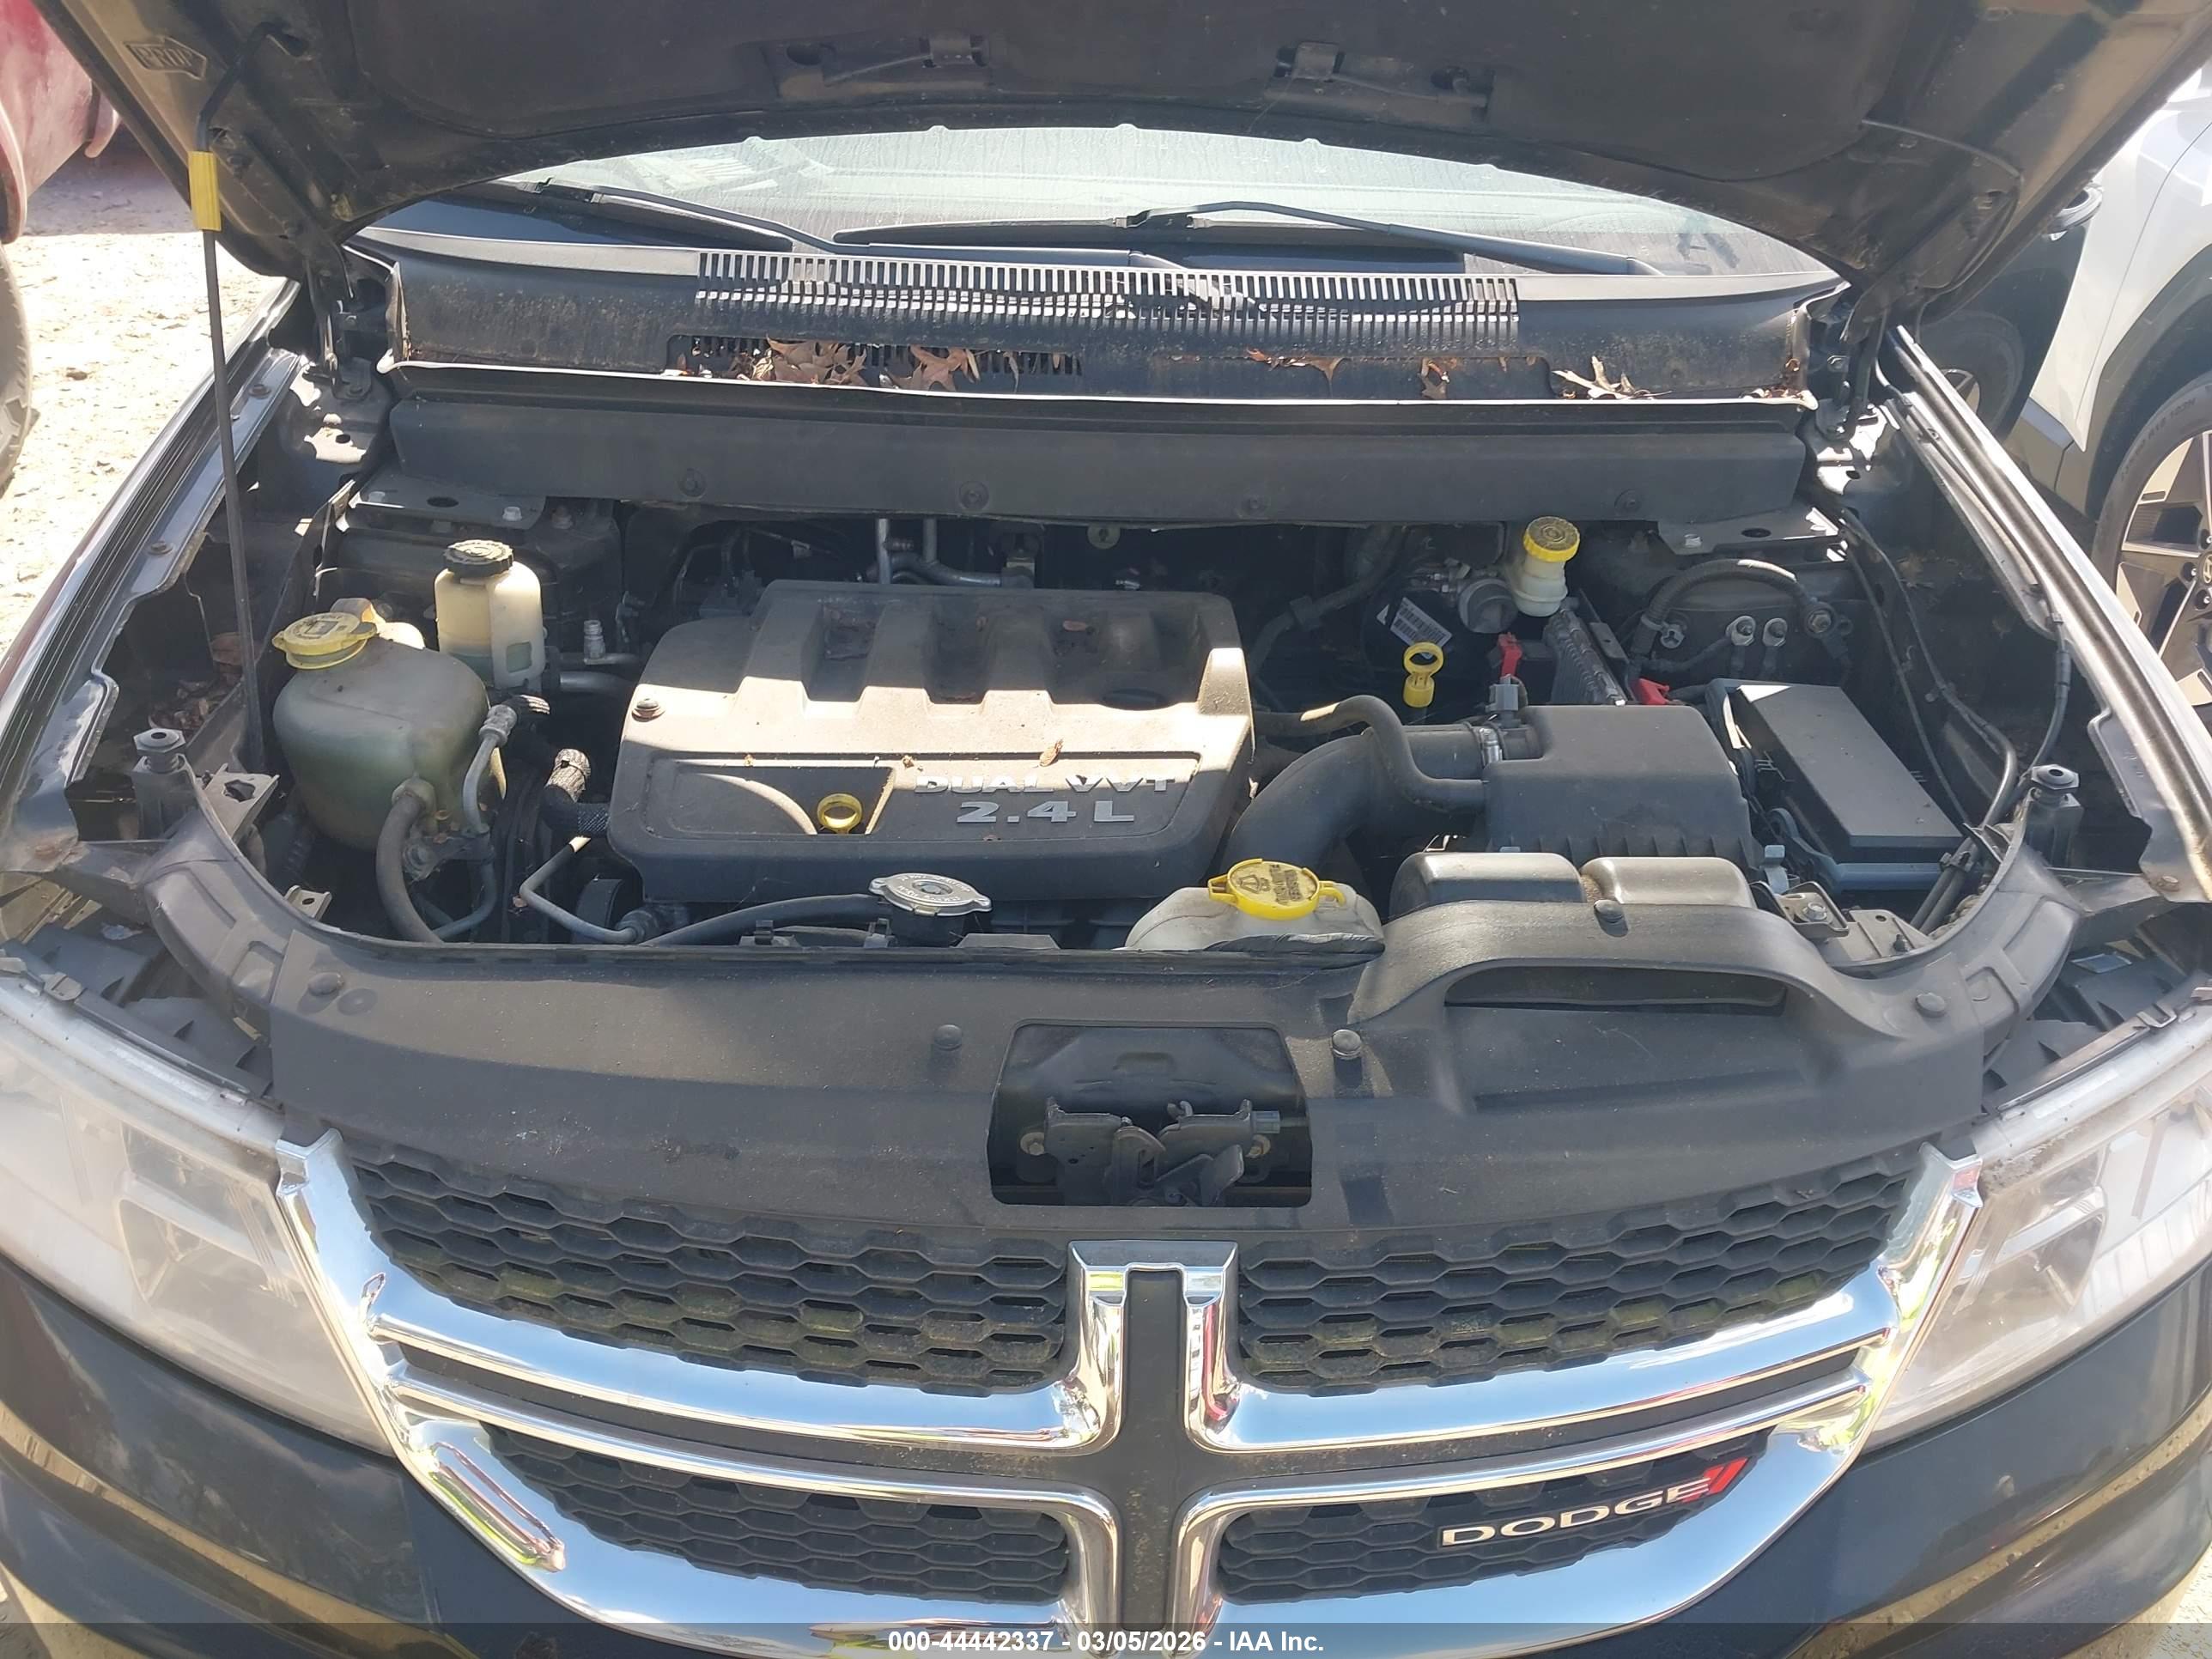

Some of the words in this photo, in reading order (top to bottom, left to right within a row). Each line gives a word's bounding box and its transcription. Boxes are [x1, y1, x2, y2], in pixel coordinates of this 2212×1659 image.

[914, 775, 1054, 794] DUAL
[1065, 775, 1176, 793] VVT
[957, 800, 1078, 823] 2.4
[1093, 800, 1135, 823] L
[1442, 1476, 1711, 1547] DODGE
